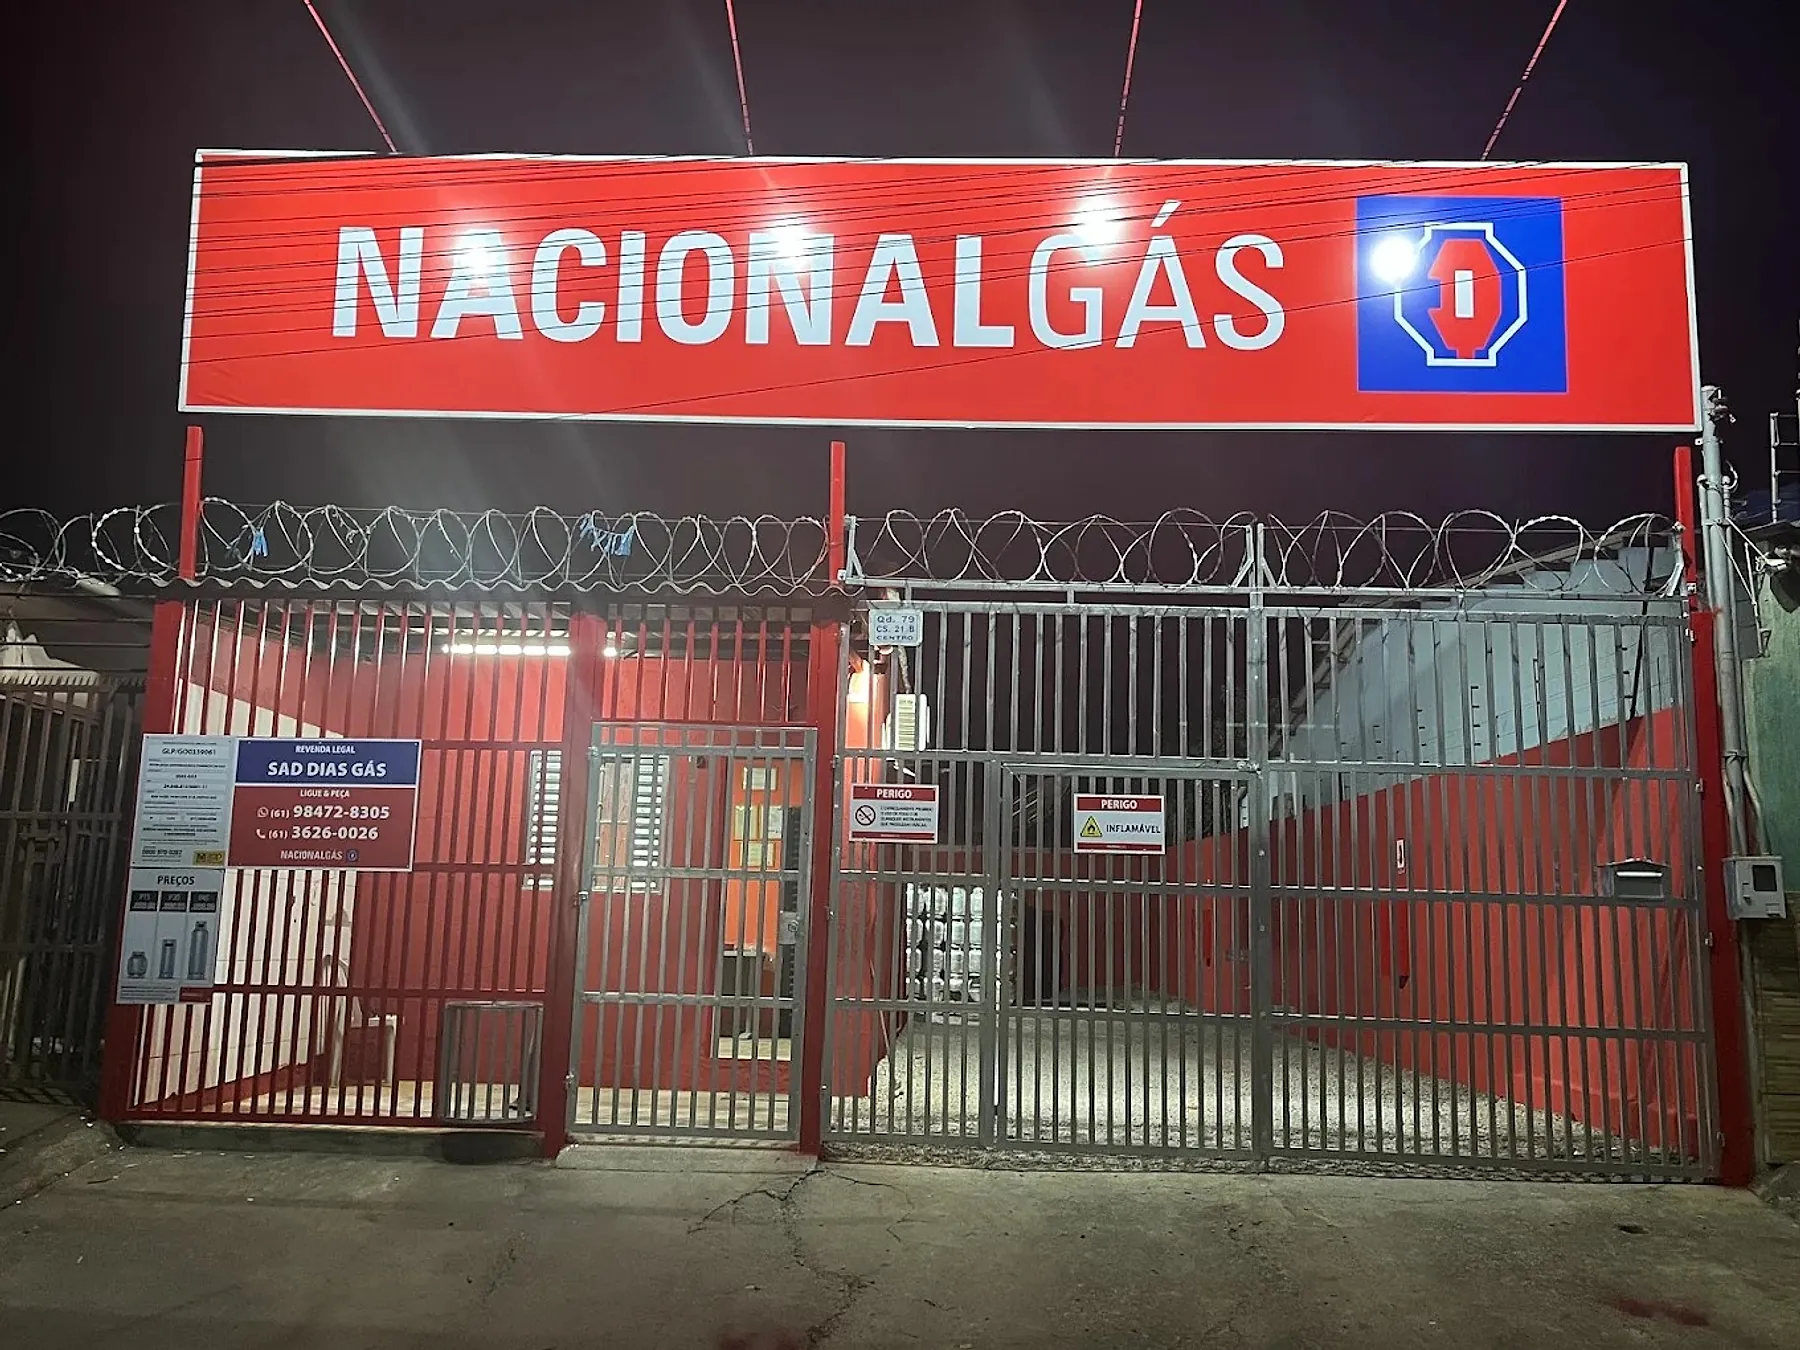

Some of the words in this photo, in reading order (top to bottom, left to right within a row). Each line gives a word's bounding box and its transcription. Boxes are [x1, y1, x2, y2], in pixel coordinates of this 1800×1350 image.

[332, 199, 1285, 351] NACIONALGÁS
[894, 625, 904, 633] 21
[909, 625, 915, 633] B
[295, 745, 331, 754] REVENDA
[332, 745, 356, 754] LEGAL
[267, 761, 303, 776] SAD
[307, 762, 348, 777] DIAS
[351, 759, 387, 777] GÁS
[300, 789, 322, 798] LIGUE
[330, 789, 350, 799] PEÇA
[876, 788, 913, 799] PERIGO
[1101, 798, 1138, 810] PERIGO
[270, 808, 290, 819] (61)
[293, 804, 390, 819] 98472-8305
[268, 829, 288, 840] (61)
[291, 825, 379, 840] 3626-0026
[1106, 823, 1161, 834] INFLAMÁVEL
[280, 850, 343, 861] NACIONALGÁS
[157, 874, 195, 887] PREÇOS
